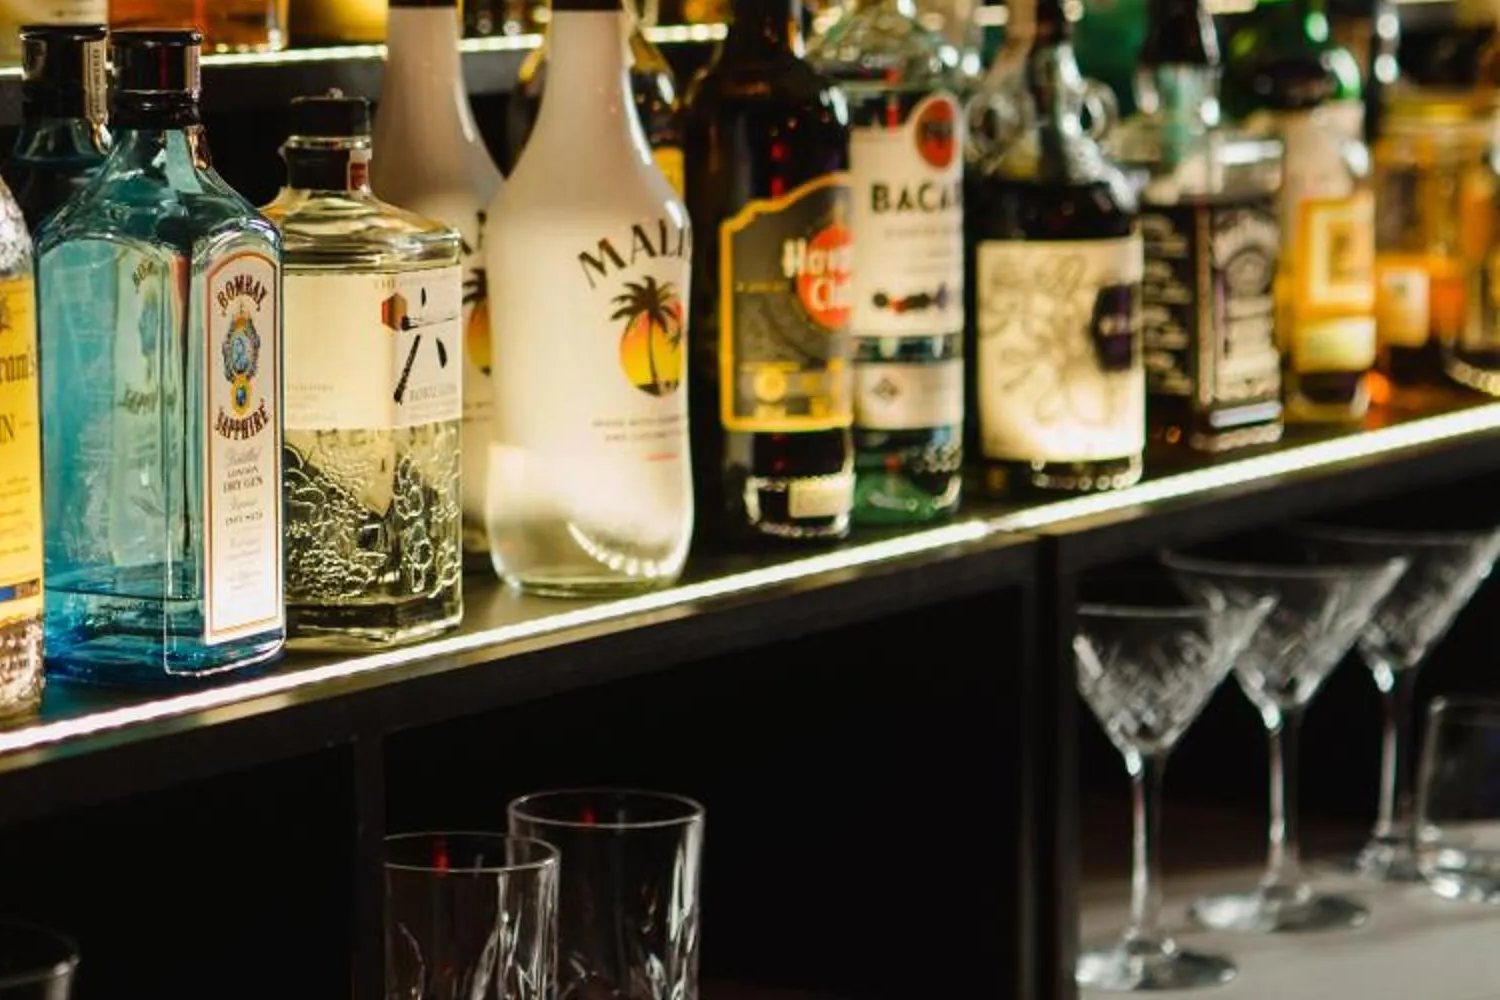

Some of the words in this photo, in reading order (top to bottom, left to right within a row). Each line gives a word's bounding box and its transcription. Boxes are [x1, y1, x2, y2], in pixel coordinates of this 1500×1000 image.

[872, 182, 961, 213] BACA
[578, 218, 691, 289] MALI
[217, 274, 268, 317] BOMBAY
[214, 398, 270, 440] SAPPHIRE
